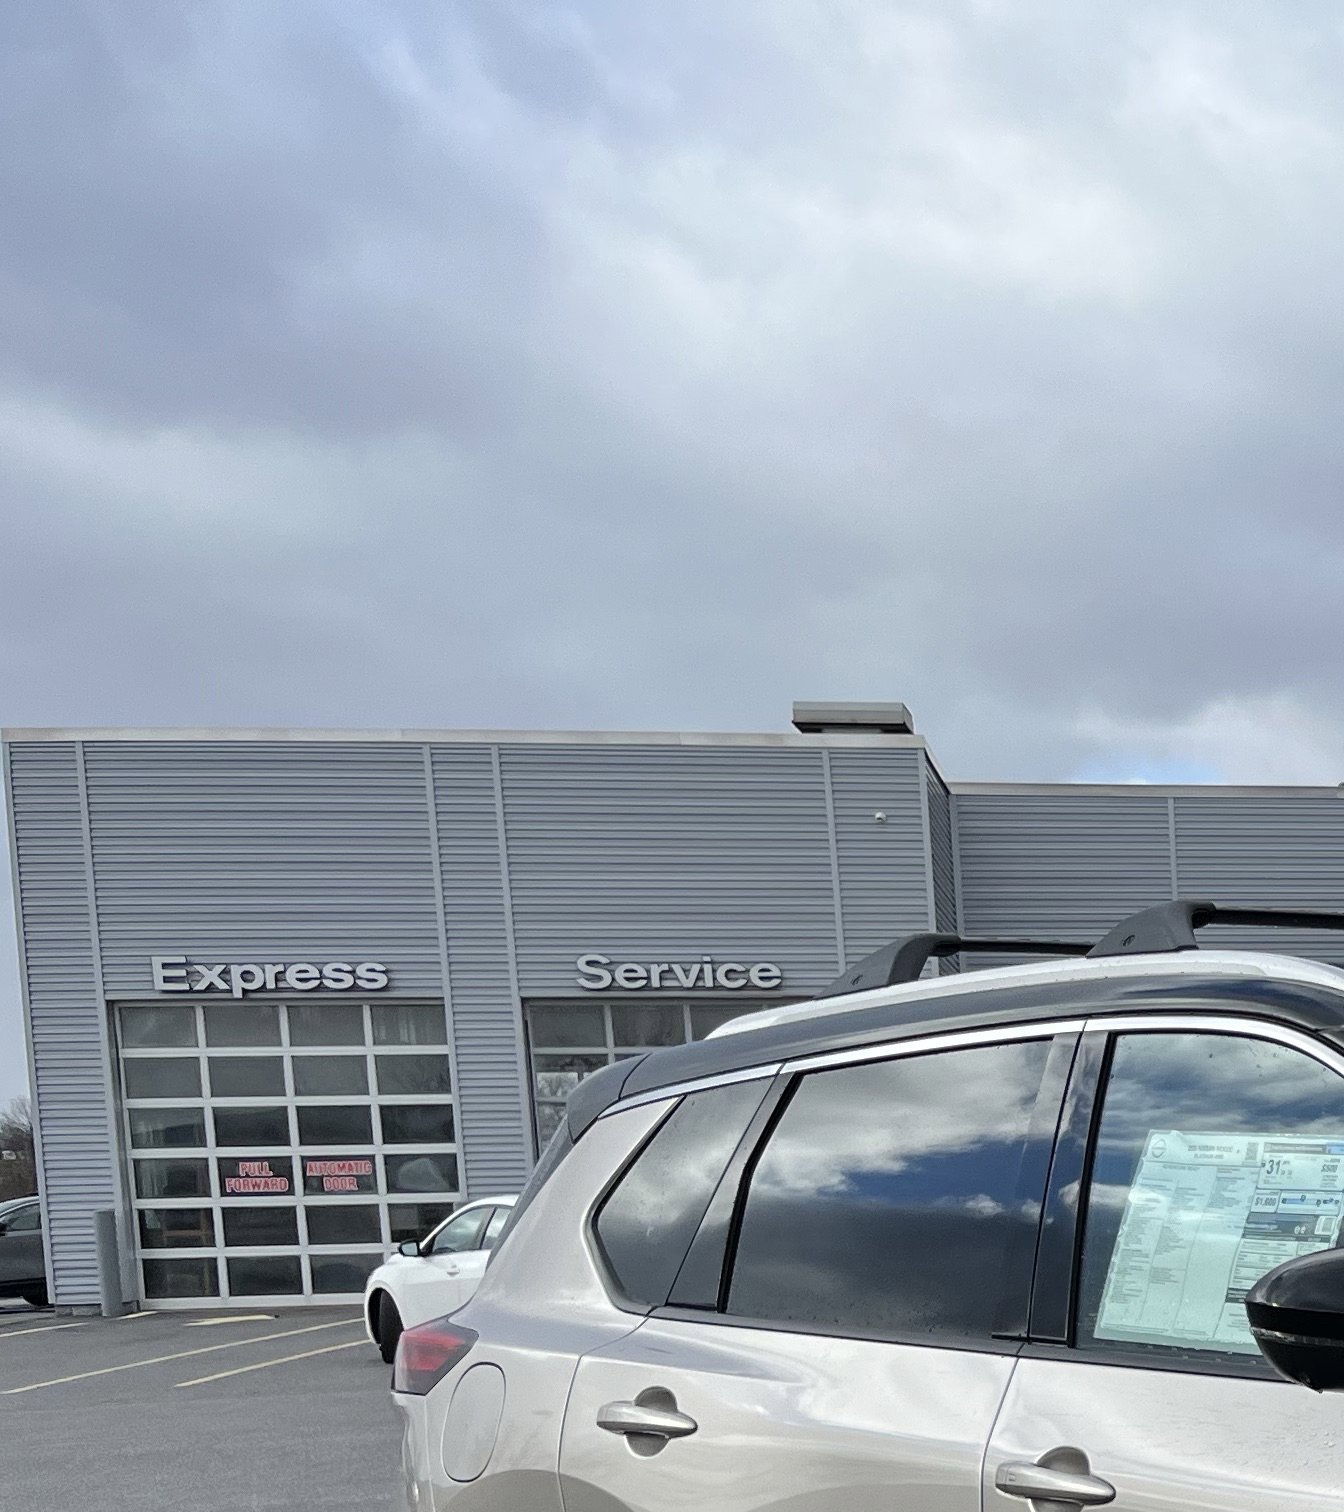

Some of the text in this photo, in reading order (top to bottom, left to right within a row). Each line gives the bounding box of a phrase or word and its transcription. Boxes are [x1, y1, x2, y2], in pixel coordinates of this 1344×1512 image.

[152, 955, 389, 997] Express
[576, 953, 782, 990] Service
[239, 1161, 273, 1177] PULL
[306, 1160, 372, 1176] AUTOMATIC
[225, 1177, 289, 1193] FORWARD
[323, 1177, 358, 1192] DOOR
